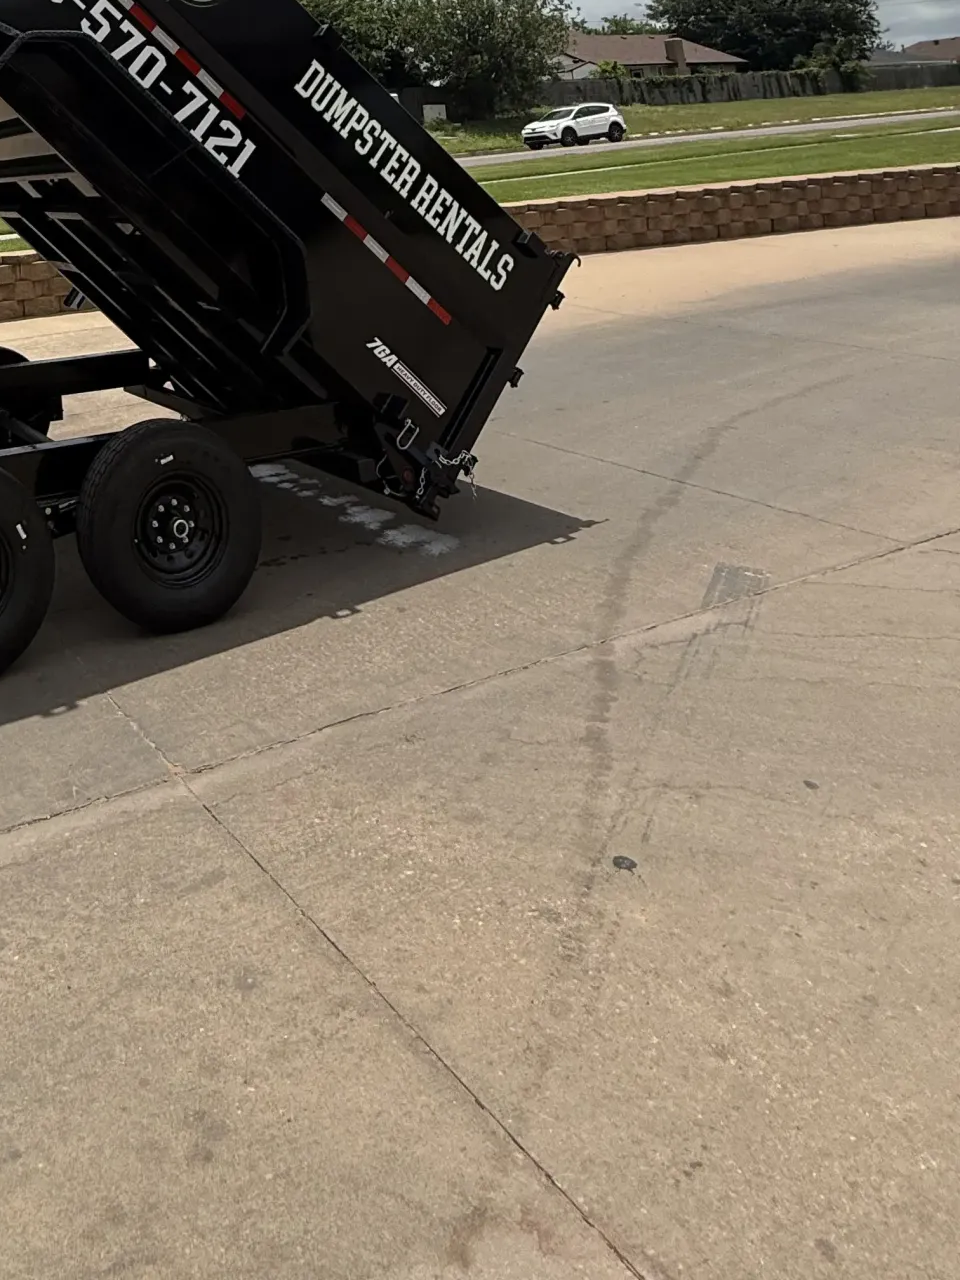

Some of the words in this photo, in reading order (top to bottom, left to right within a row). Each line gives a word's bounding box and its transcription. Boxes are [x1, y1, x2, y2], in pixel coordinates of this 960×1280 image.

[294, 58, 421, 199] DUMPSTER
[410, 174, 514, 291] RENTALS
[365, 336, 398, 368] 7GA
[396, 365, 414, 383] HEAVY
[412, 382, 427, 397] DUTY
[425, 395, 442, 413] FLOOR
